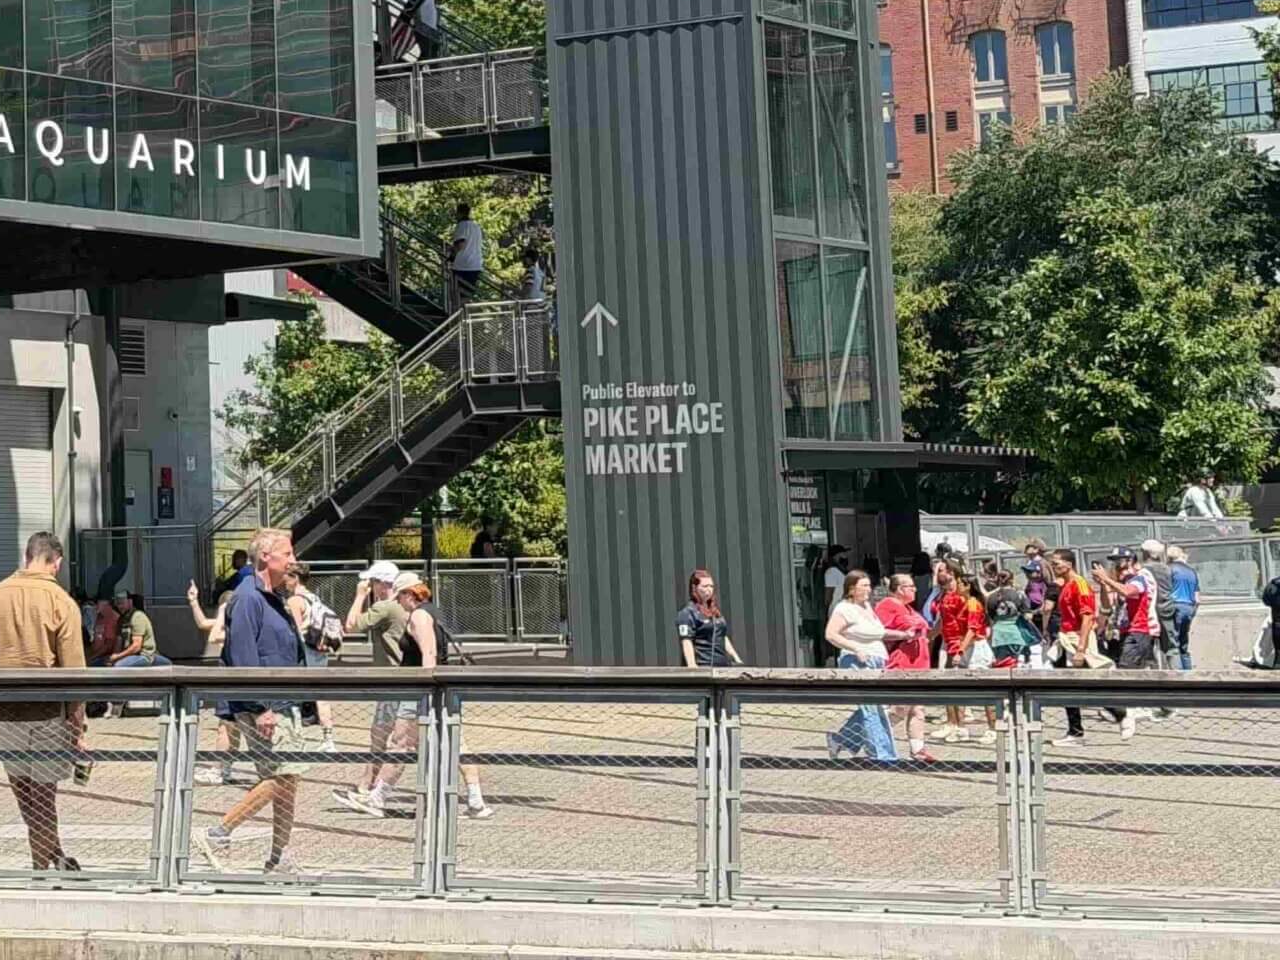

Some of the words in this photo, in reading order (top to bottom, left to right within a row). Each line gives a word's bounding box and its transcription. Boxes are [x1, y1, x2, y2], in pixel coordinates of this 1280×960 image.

[582, 383, 623, 400] Public
[625, 381, 680, 398] Elevator
[682, 381, 696, 395] to
[583, 406, 639, 437] PIKE
[645, 402, 725, 435] PLACE
[585, 442, 688, 475] MARKET
